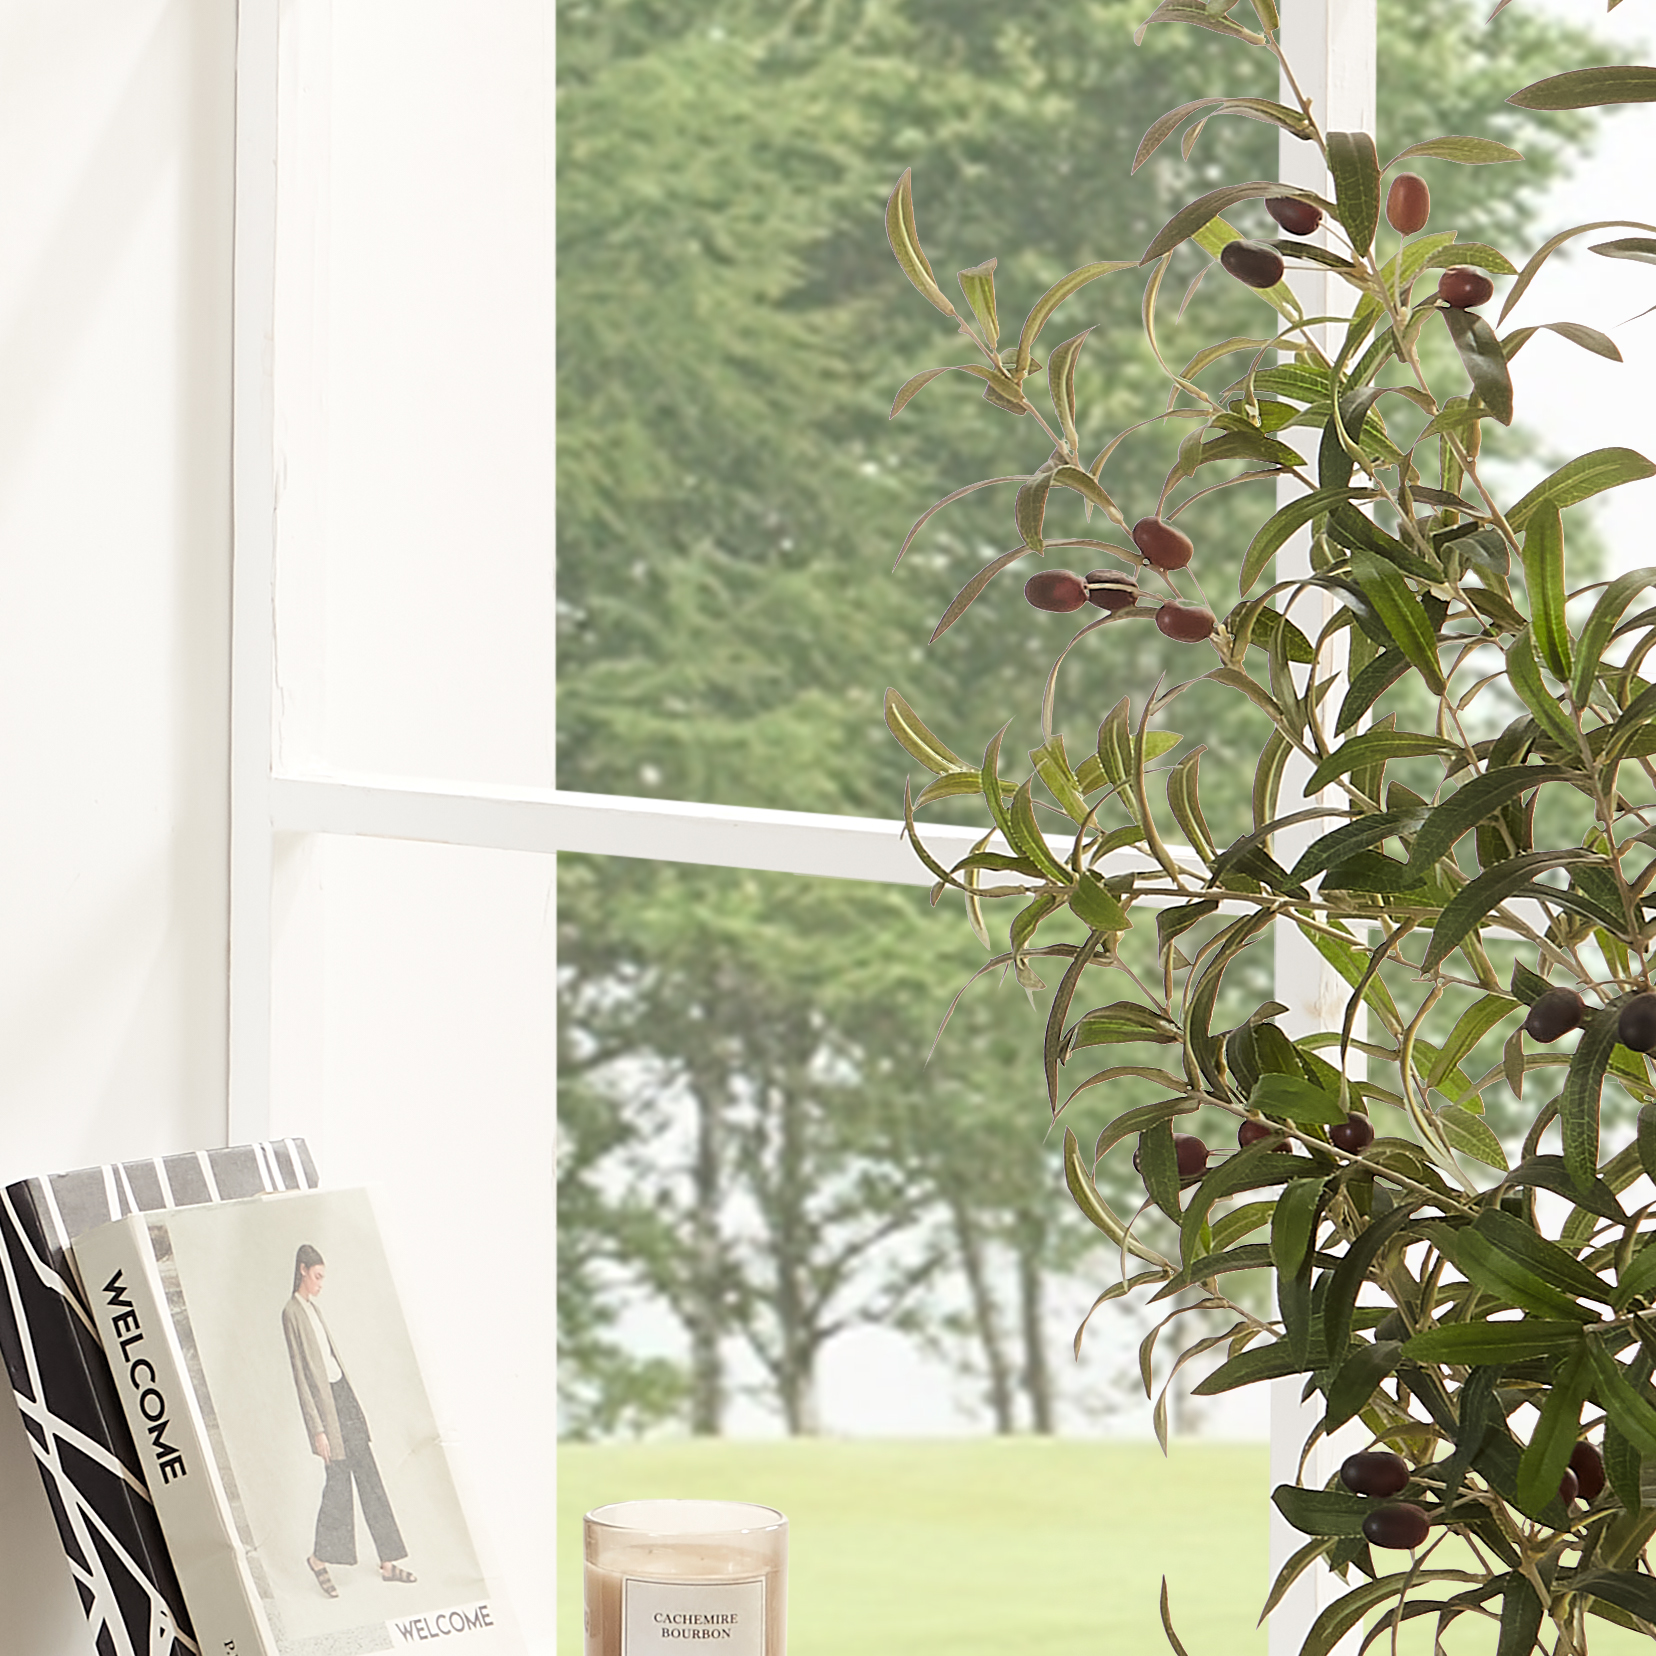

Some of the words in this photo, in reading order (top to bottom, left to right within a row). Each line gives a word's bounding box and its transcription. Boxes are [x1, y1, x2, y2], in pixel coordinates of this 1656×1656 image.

[101, 1269, 188, 1485] WELCOME
[395, 1604, 494, 1643] WELCOME
[653, 1612, 739, 1625] CACHEMIRE
[661, 1627, 732, 1639] BOURBON
